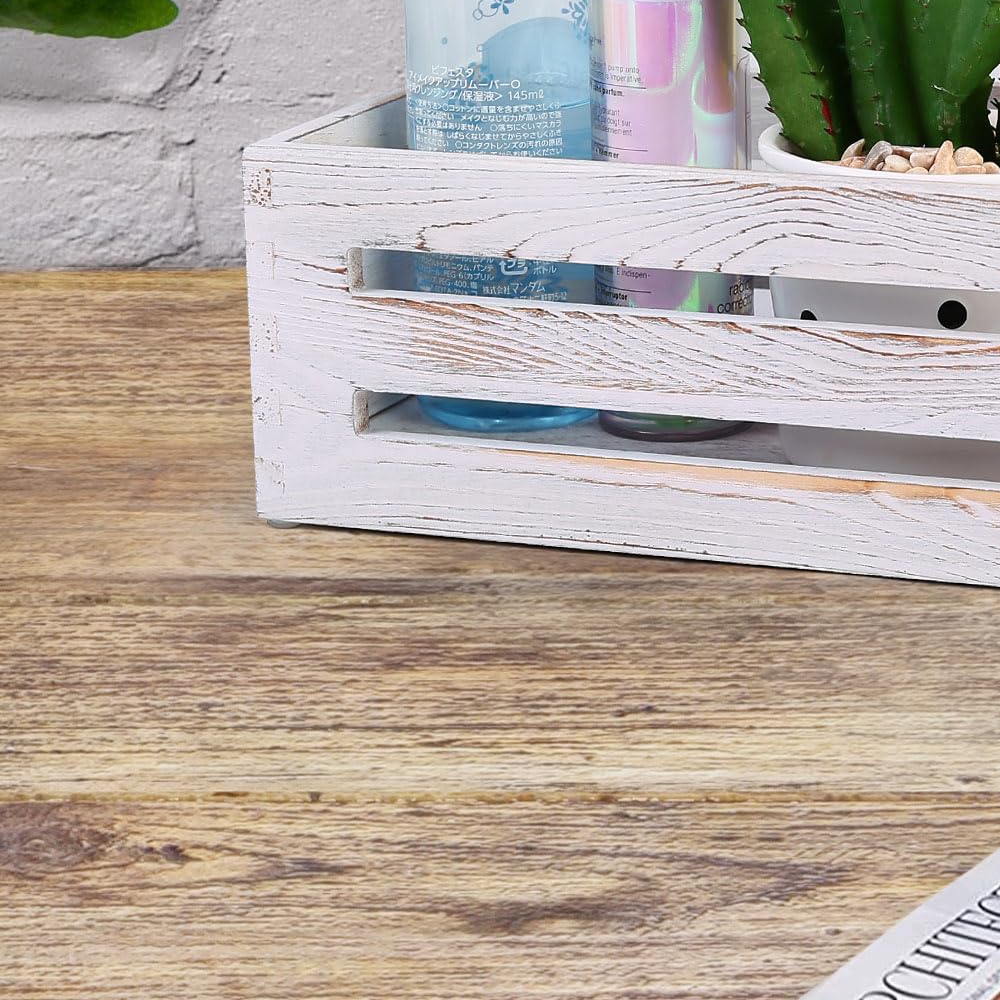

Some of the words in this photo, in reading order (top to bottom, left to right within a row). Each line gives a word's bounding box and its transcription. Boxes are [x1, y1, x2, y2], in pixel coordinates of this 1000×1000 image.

[431, 64, 474, 78] ビフェスタ
